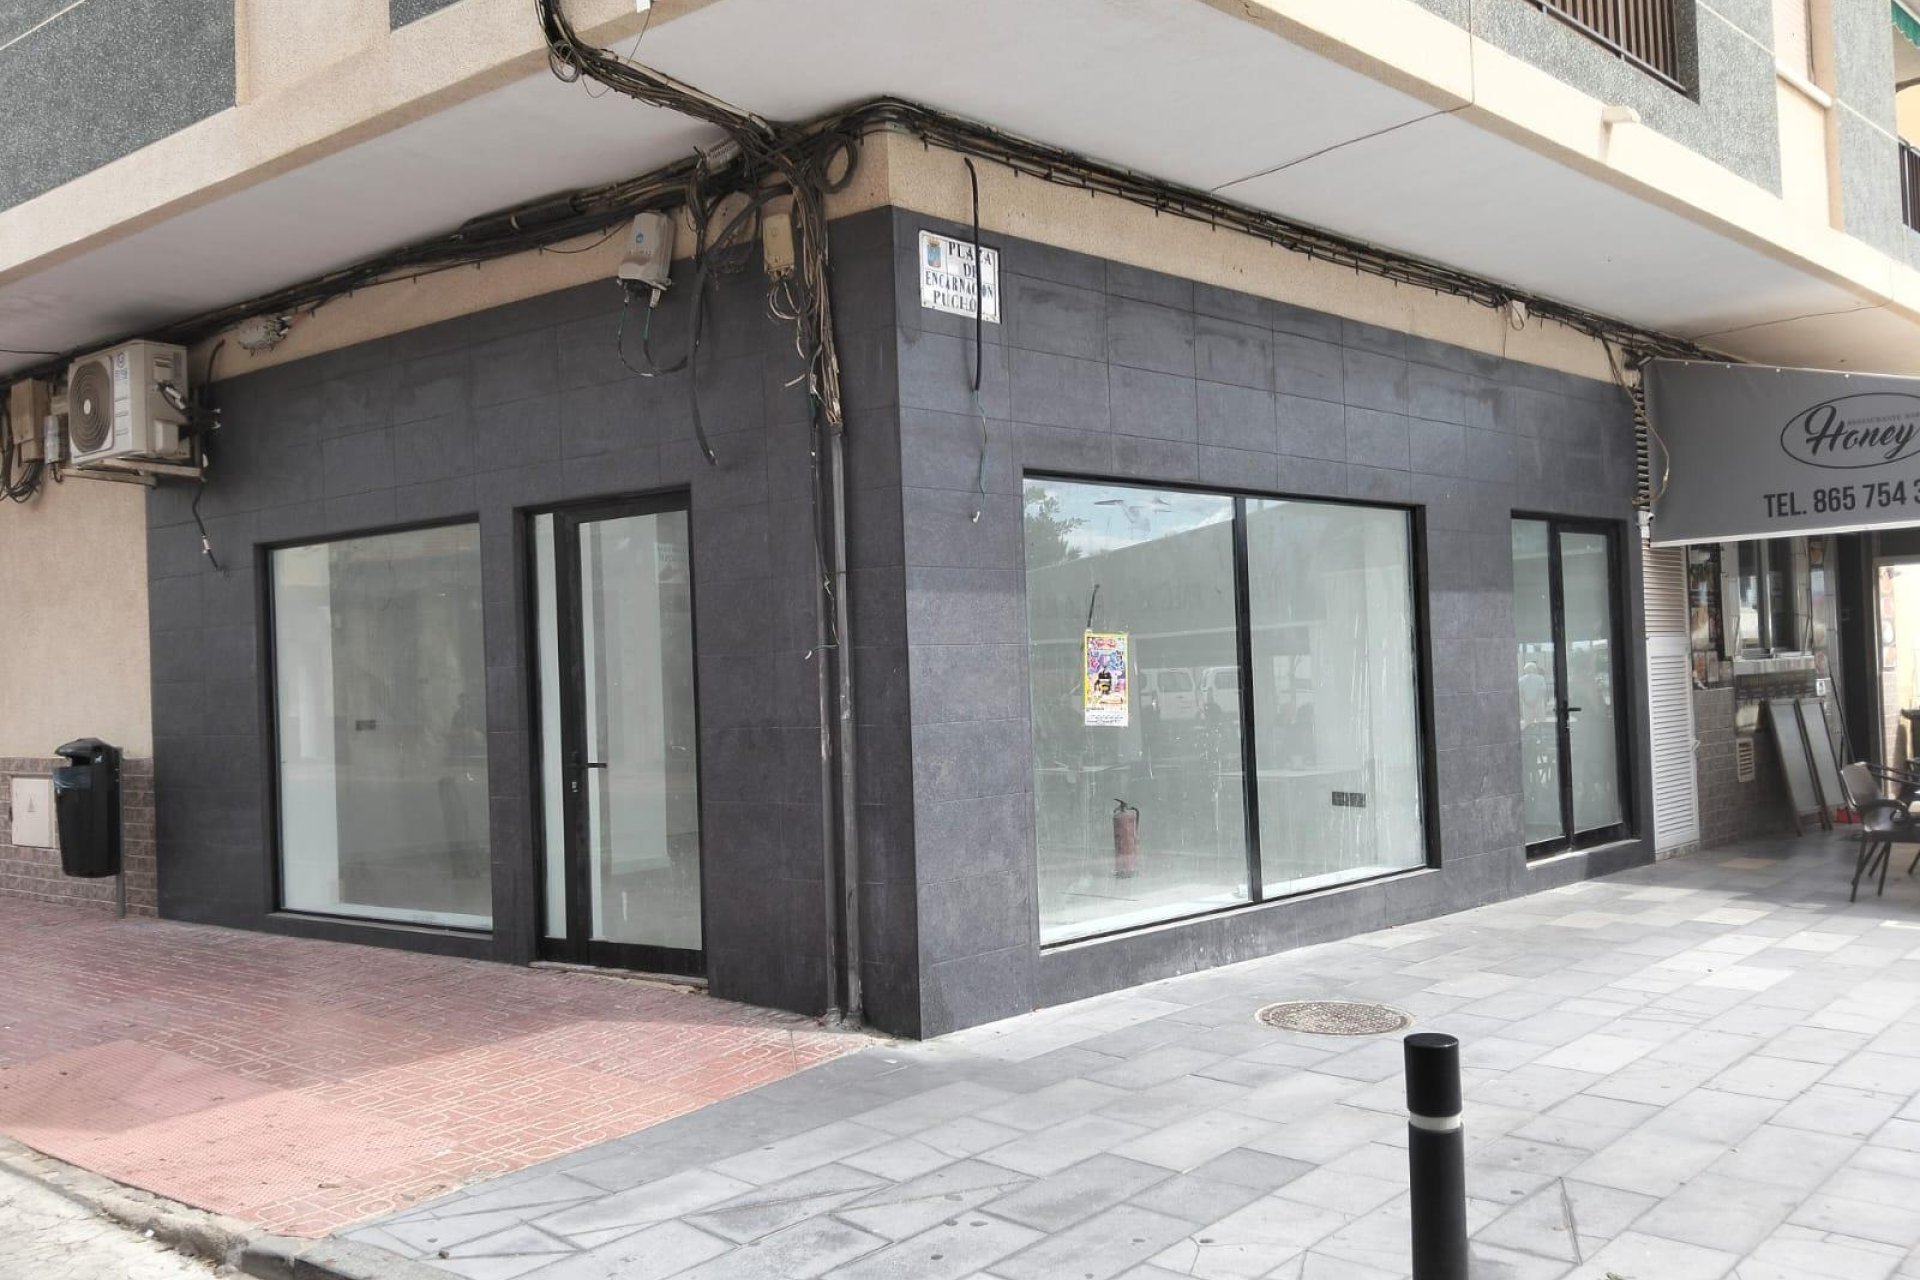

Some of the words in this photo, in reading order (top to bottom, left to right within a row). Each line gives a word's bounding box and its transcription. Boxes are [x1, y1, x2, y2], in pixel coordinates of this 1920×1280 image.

[925, 271, 993, 299] ENCARNACON
[933, 289, 980, 313] PUCHO
[1804, 405, 1918, 459] Honey
[1763, 492, 1807, 518] TEL.
[1813, 486, 1856, 513] 865
[1862, 480, 1907, 508] 754
